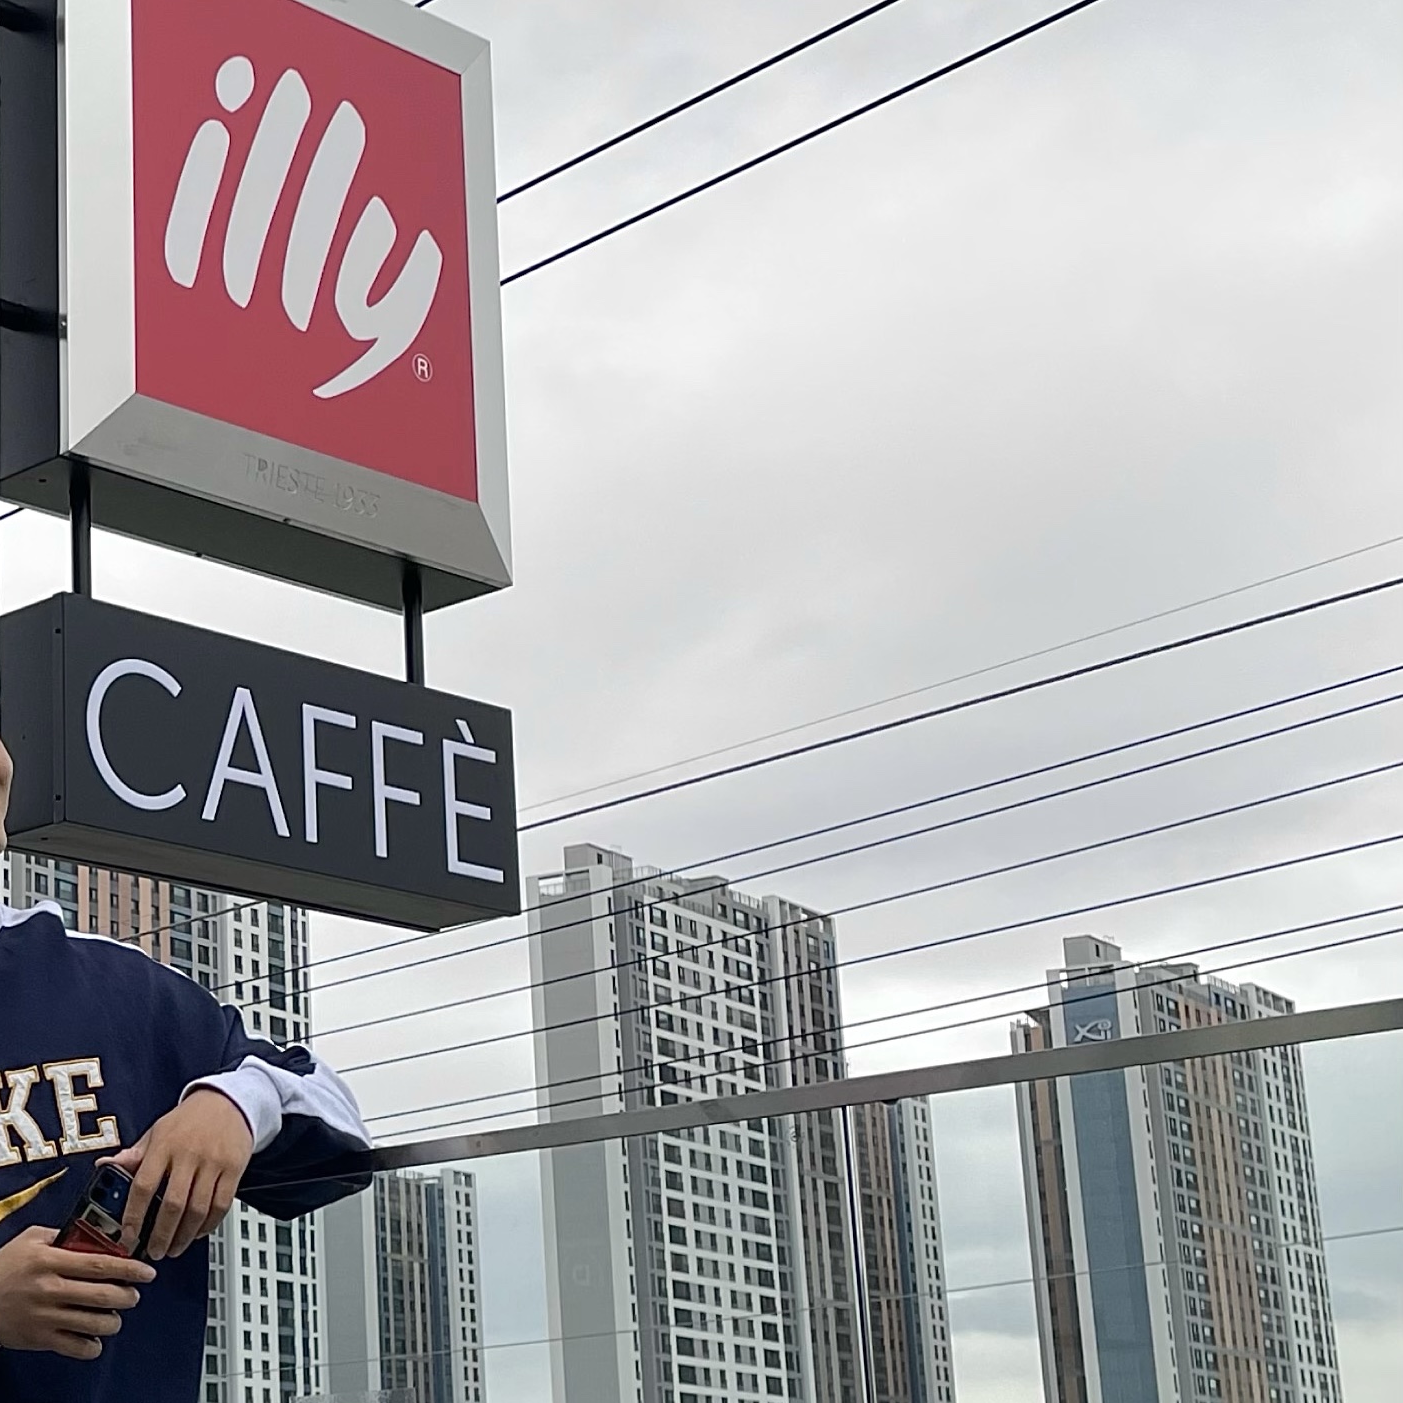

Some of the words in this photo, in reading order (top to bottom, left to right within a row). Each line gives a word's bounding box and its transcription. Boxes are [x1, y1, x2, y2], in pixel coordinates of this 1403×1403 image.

[164, 55, 443, 399] illy
[243, 452, 326, 503] TRIESTE
[86, 658, 505, 884] CAFFÈ
